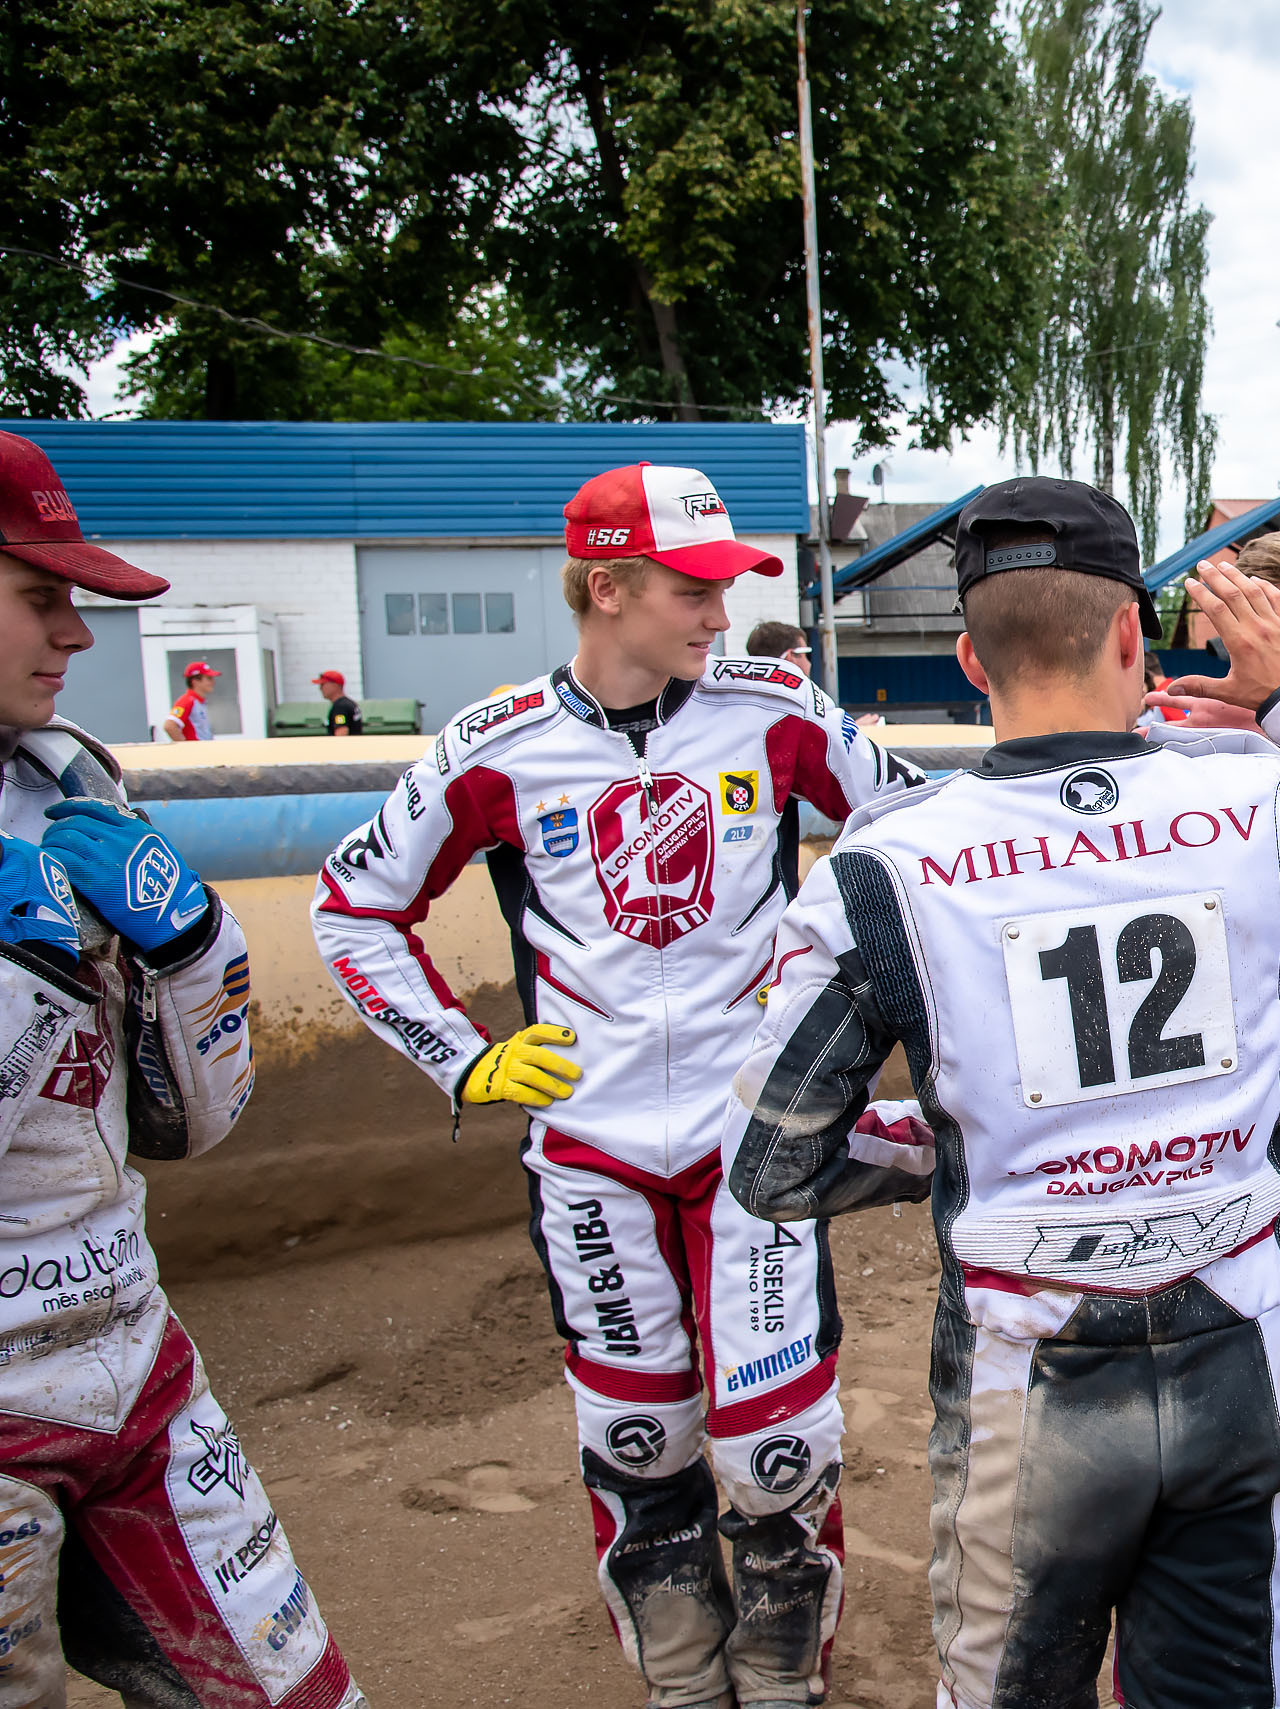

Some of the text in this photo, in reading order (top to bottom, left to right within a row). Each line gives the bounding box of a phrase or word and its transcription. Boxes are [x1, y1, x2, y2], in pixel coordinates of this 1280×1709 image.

[586, 528, 631, 546] #56
[606, 788, 695, 879] LOKOMOTIV
[657, 809, 706, 856] DAUGAVPILS
[688, 820, 706, 837] CLUB
[918, 805, 1258, 887] MIHAILOV
[1038, 913, 1206, 1088] 12
[1046, 1159, 1215, 1196] DAUGAVPILS
[43, 1292, 79, 1312] mēs
[588, 1263, 625, 1294] &
[749, 1246, 760, 1332] ANNO 1989
[762, 1222, 802, 1333] AUSEKLIS
[594, 1296, 642, 1356] JBM
